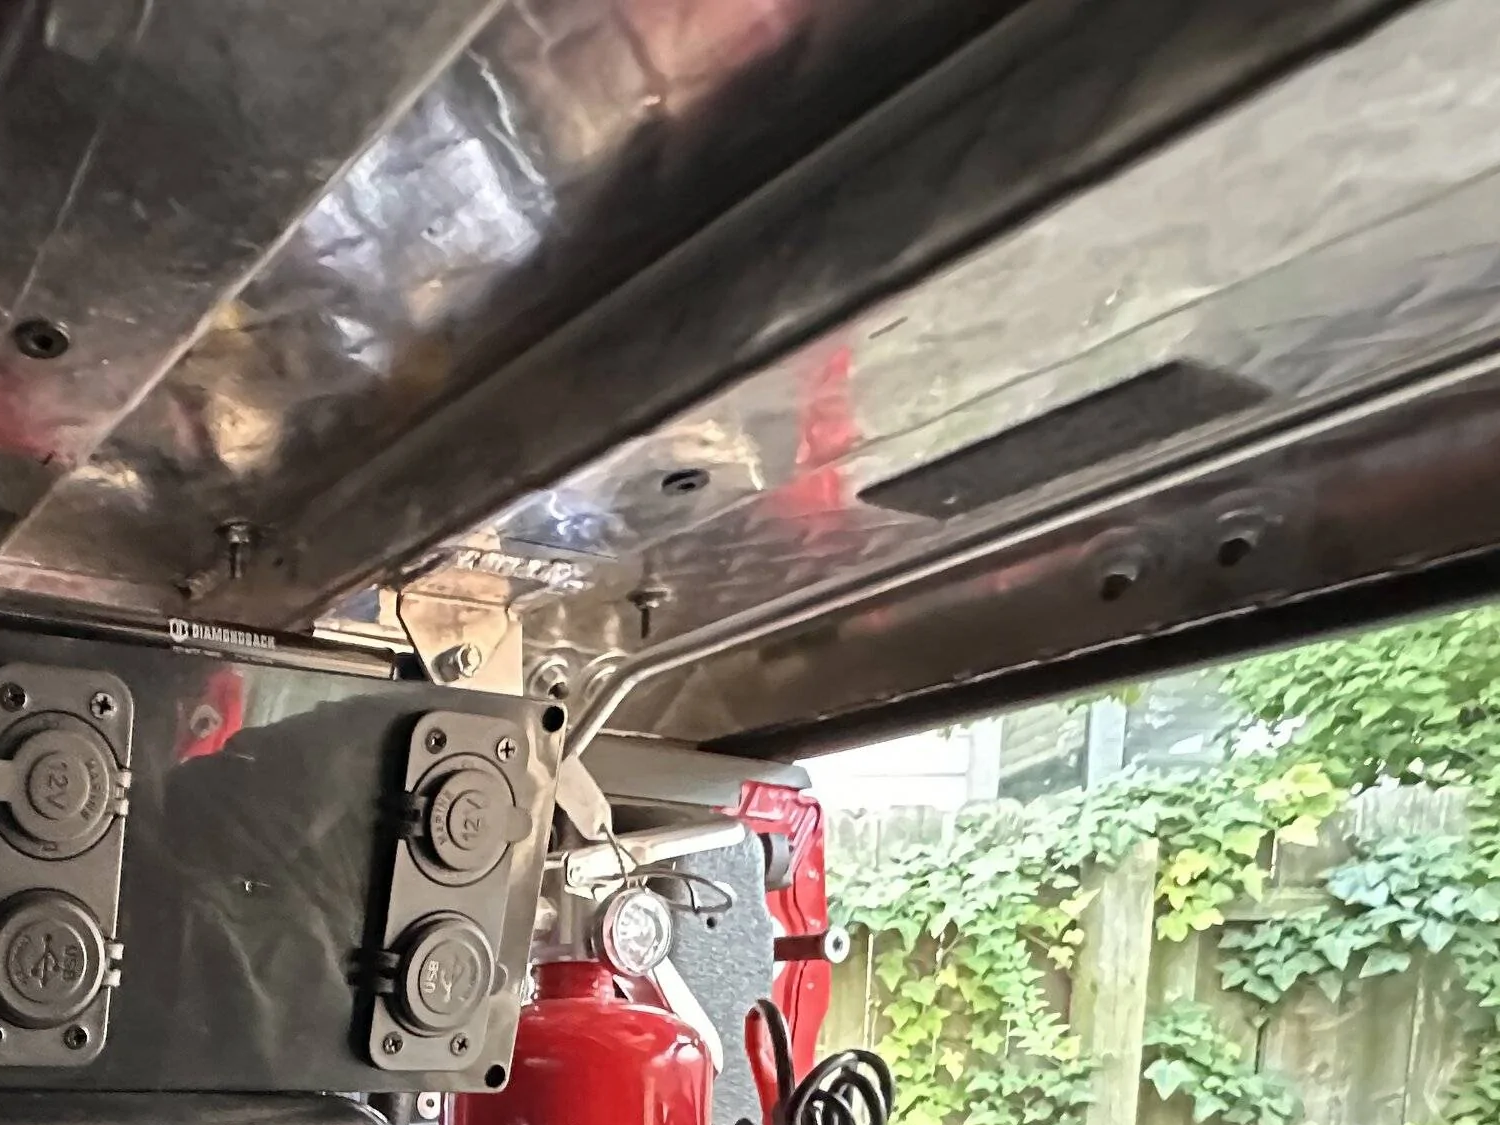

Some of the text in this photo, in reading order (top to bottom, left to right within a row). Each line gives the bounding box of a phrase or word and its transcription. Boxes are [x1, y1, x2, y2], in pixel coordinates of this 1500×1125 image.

[192, 624, 276, 649] DIAMONDBACK
[46, 761, 69, 810] 12V
[461, 797, 486, 842] 12V
[61, 944, 78, 981] USB
[422, 960, 440, 994] USB
